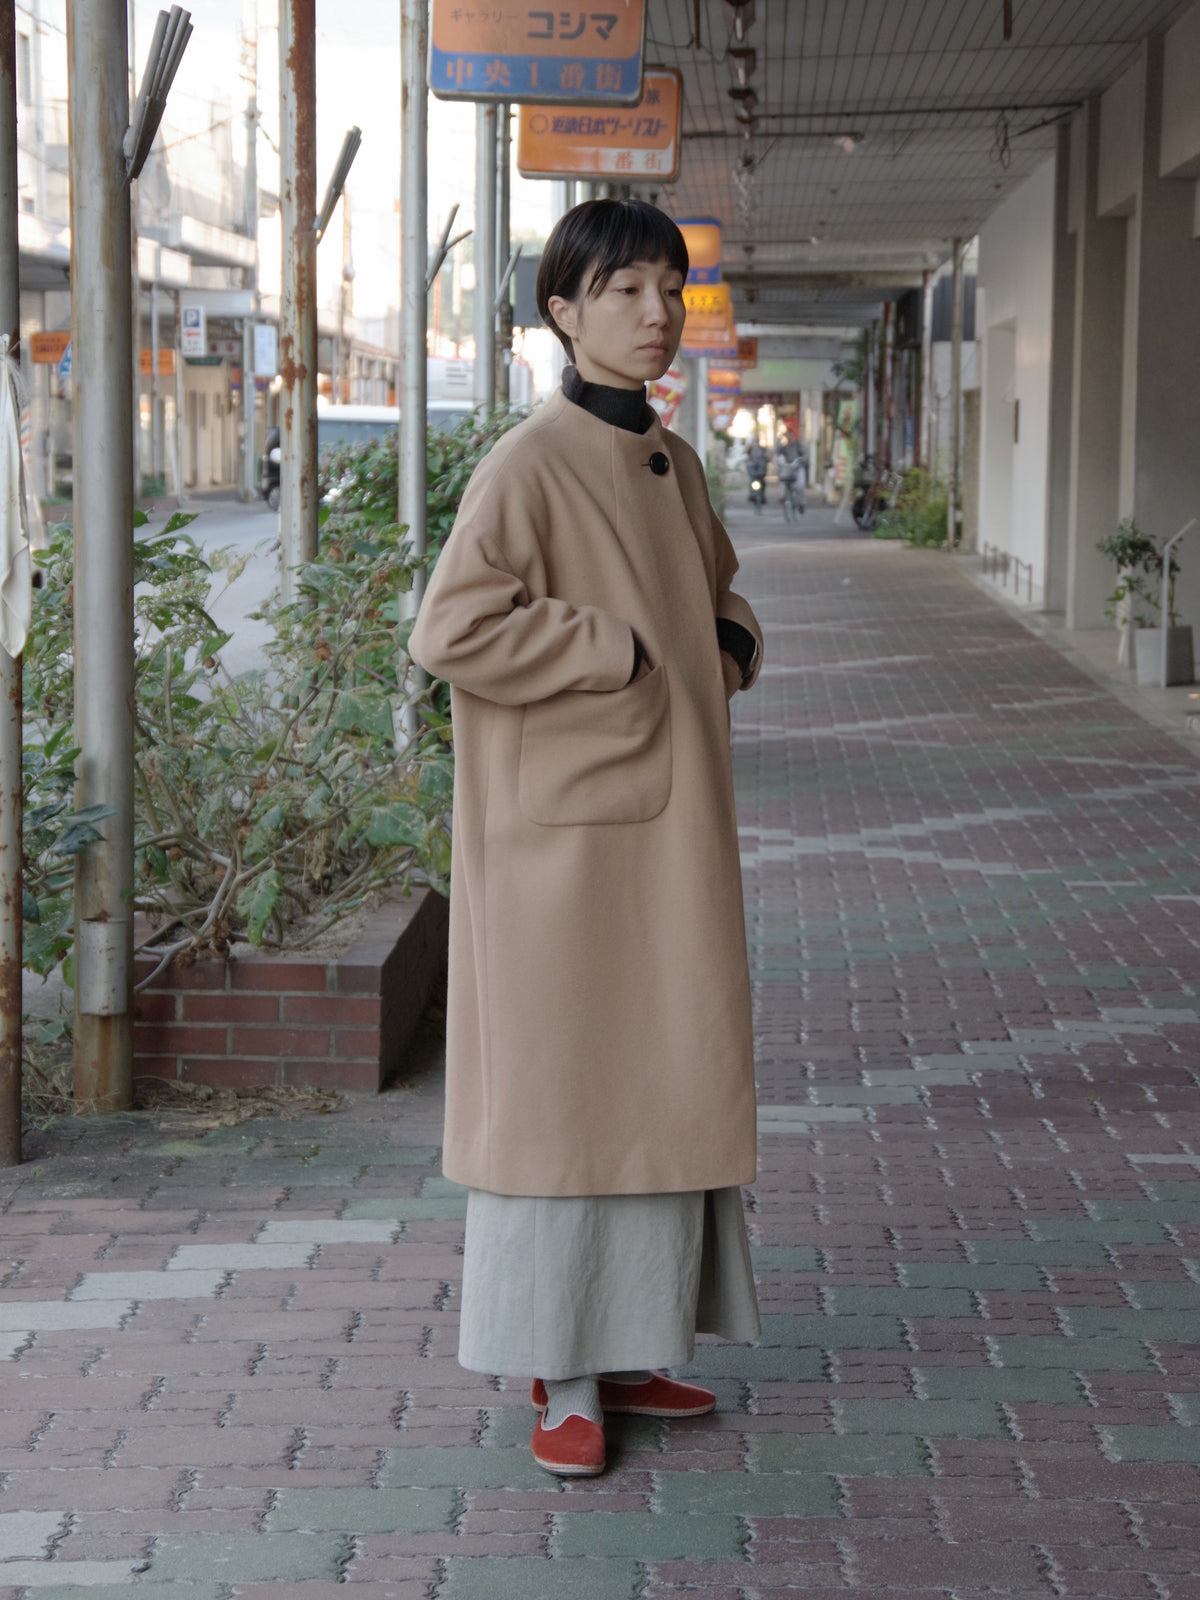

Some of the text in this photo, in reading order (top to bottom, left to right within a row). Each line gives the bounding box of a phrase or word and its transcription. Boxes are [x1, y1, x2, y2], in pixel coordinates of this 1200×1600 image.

[449, 8, 519, 23] ギャラリー
[527, 11, 619, 40] コシマ
